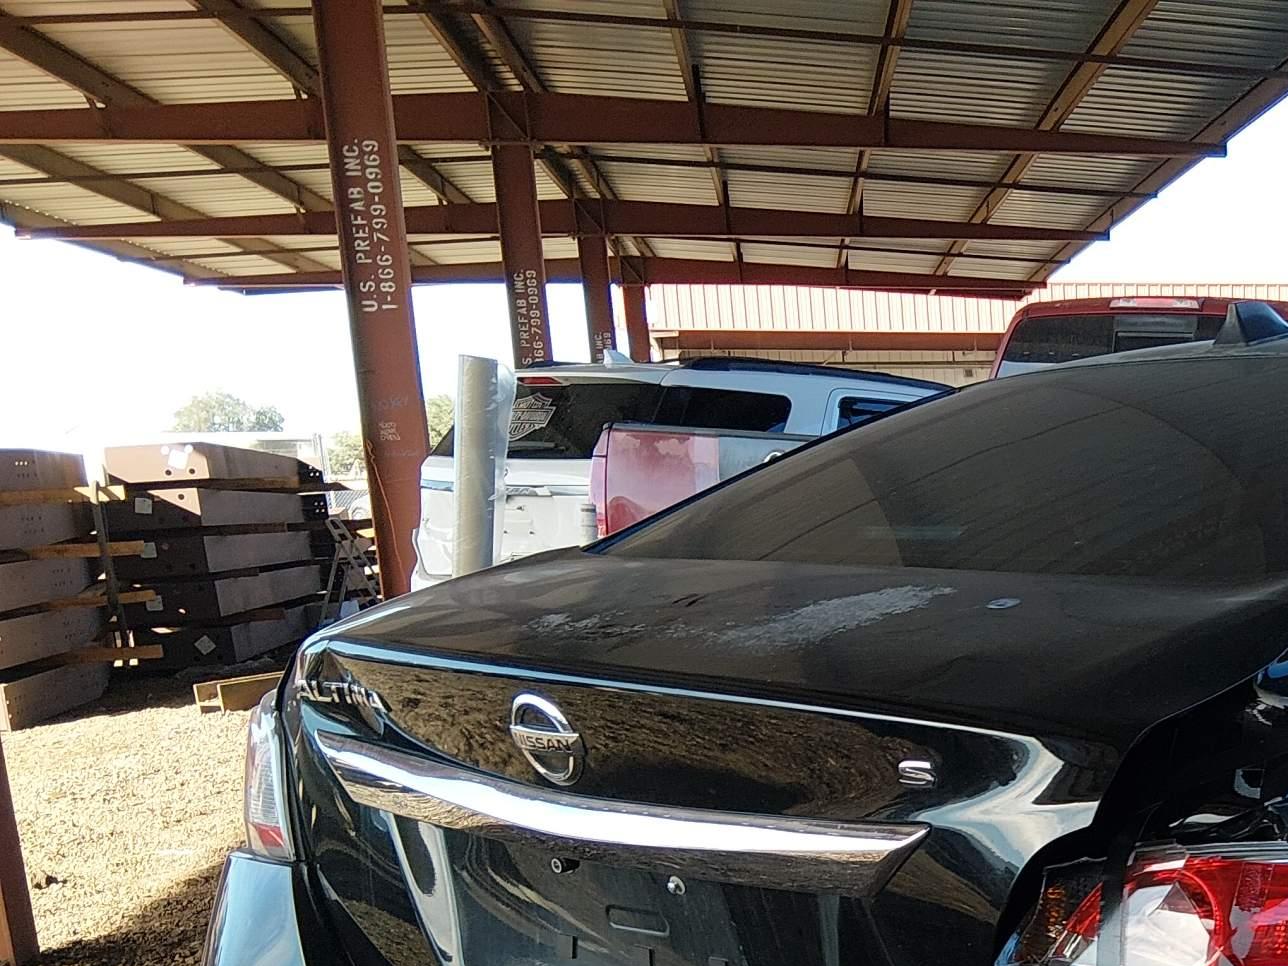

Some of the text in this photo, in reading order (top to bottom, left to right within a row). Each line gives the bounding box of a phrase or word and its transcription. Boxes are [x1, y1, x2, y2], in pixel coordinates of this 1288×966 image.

[342, 138, 378, 312] U.S. PREFAB INC.
[361, 140, 399, 310] 1-866-799-0969
[513, 269, 525, 293] INC.
[515, 298, 531, 348] PREFAB
[525, 270, 545, 363] 66-799-0969
[296, 679, 391, 713] ALTIMA
[512, 731, 572, 752] NISSAN
[898, 760, 936, 787] S
